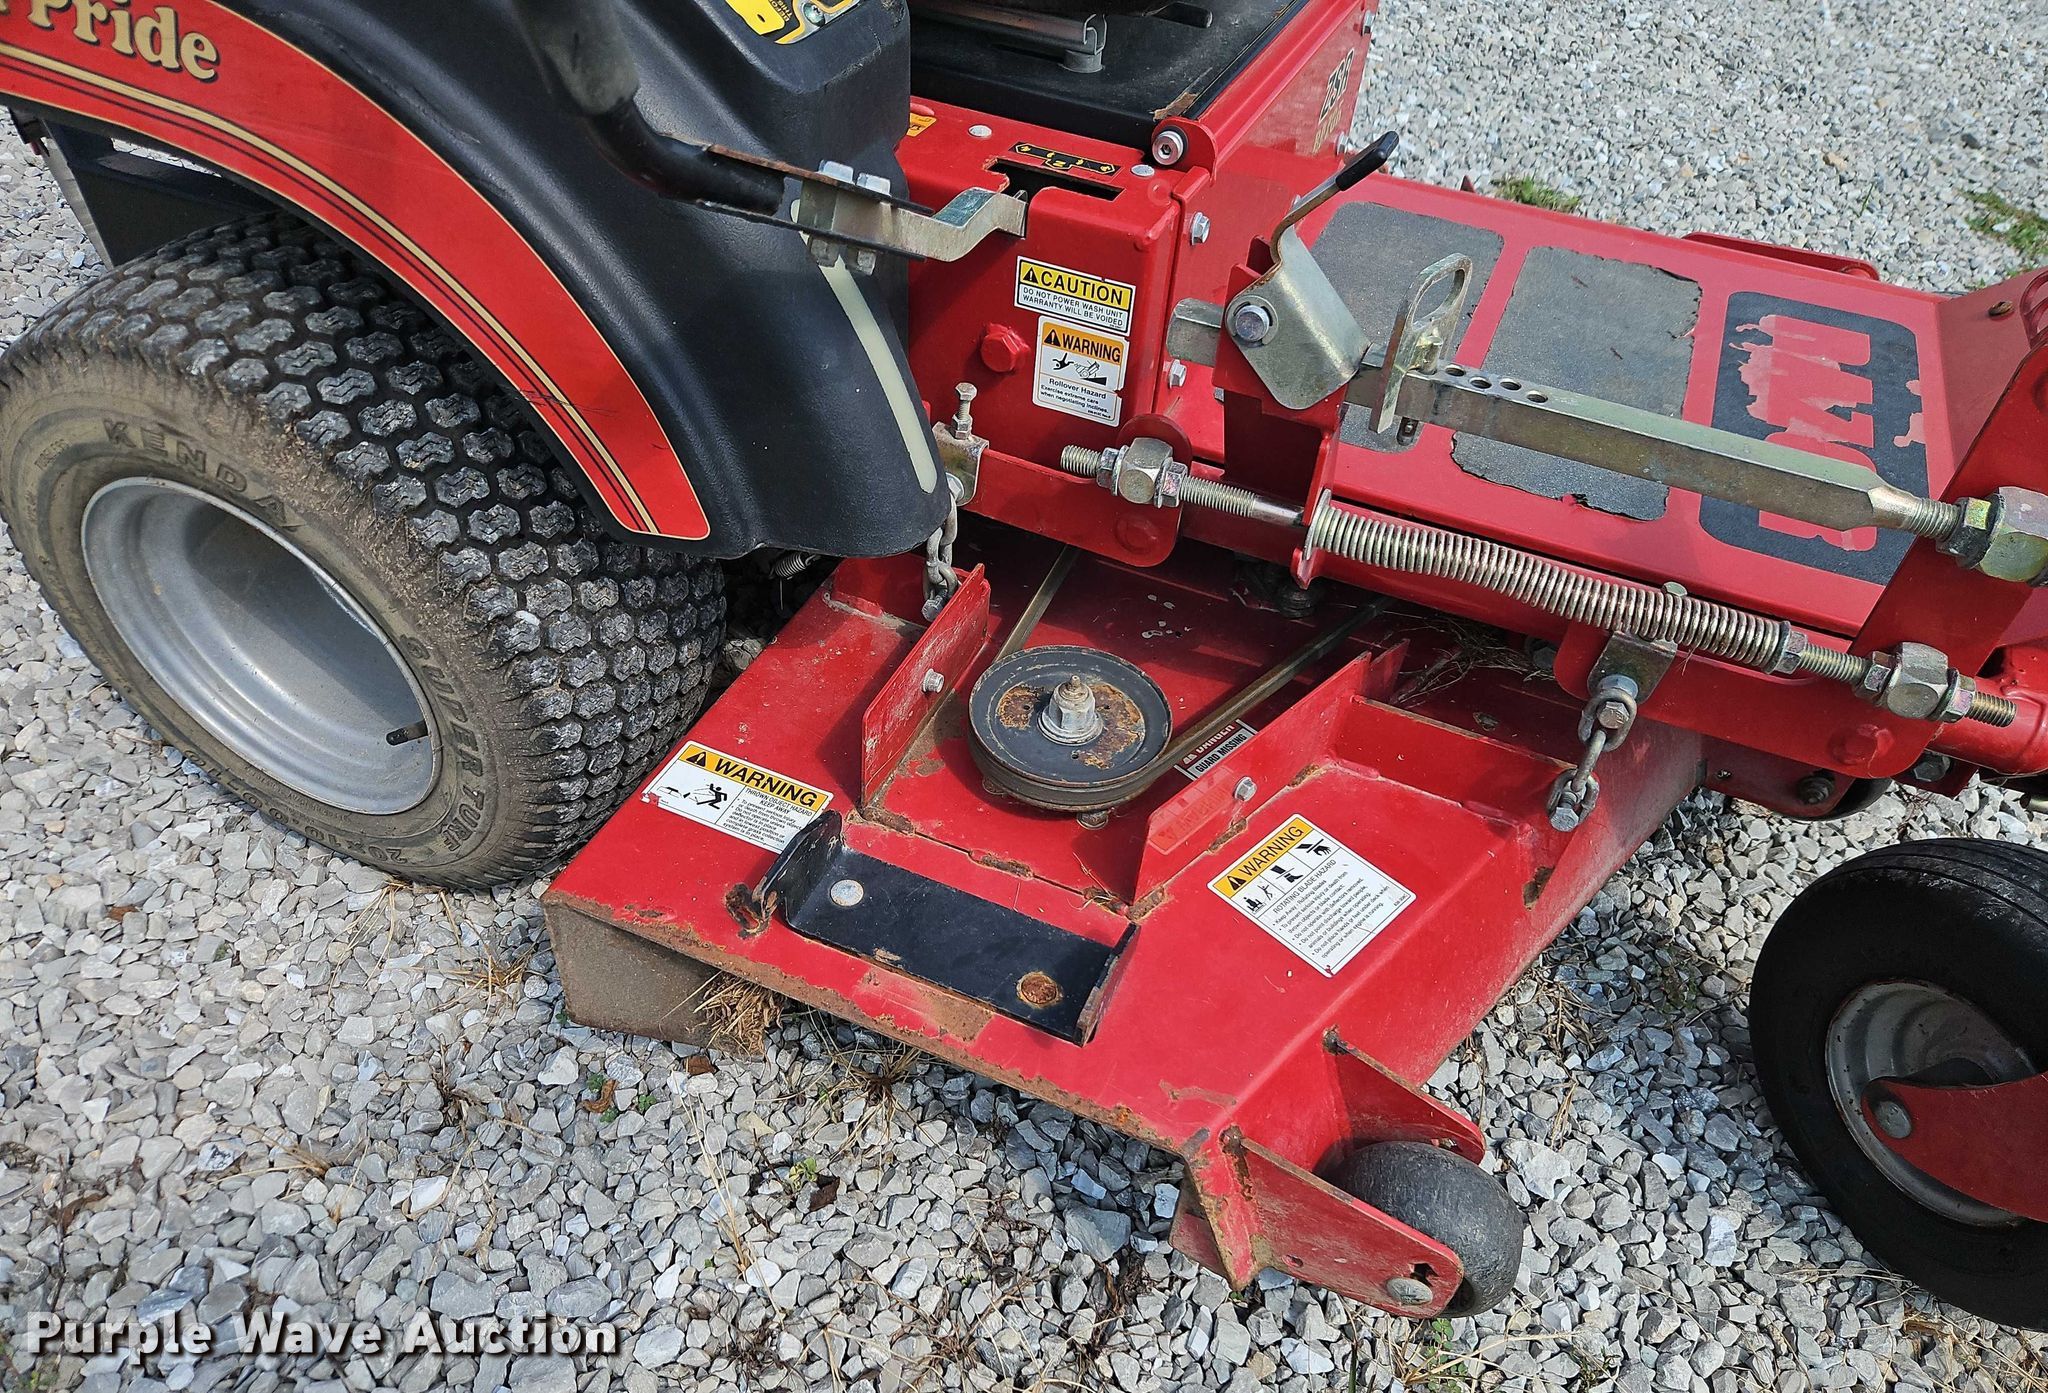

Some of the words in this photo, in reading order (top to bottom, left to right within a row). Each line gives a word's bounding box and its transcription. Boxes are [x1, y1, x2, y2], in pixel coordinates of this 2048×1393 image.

[1022, 286, 1033, 295] DO
[1035, 290, 1051, 299] NOT
[1052, 294, 1079, 307] POWER
[1081, 302, 1103, 313] WASH
[1105, 308, 1123, 318] UNIT
[1040, 270, 1122, 305] CAUTION
[1022, 294, 1062, 309] WARRANTY
[1064, 304, 1081, 315] WILL
[1083, 310, 1093, 318] BE
[1095, 313, 1122, 326] VOIDED
[1062, 332, 1121, 363] WARNING
[1048, 377, 1079, 391] Rollover
[1080, 386, 1106, 399] Hazard
[104, 418, 305, 528] KENDA
[401, 635, 484, 777] SUPER
[1195, 752, 1221, 773] GUARD
[1217, 733, 1248, 757] MISSING
[714, 757, 817, 807] WARNING
[745, 787, 768, 800] THROWN
[768, 796, 791, 808] OBJECT
[789, 804, 812, 816] HAZARD
[440, 785, 485, 851] TURF
[759, 799, 775, 807] KEEP
[774, 805, 790, 814] AWAY
[1237, 825, 1304, 876] WARNING
[1272, 890, 1300, 913] ROTATING
[1296, 875, 1317, 892] BLADE
[1314, 859, 1336, 878] HAZARD
[1274, 914, 1286, 923] Keep
[1284, 905, 1297, 915] Away
[1296, 890, 1315, 904] Rotating
[1311, 879, 1326, 891] Blades
[1286, 910, 1302, 925] prevent
[1300, 900, 1315, 912] serious
[1312, 891, 1325, 901] injury
[1328, 878, 1339, 888] death
[1337, 871, 1347, 879] from
[1287, 921, 1302, 933] thrown
[1300, 909, 1316, 922] objects
[1317, 896, 1330, 906] blade
[1300, 925, 1309, 933] not
[1306, 914, 1322, 927] operate
[1321, 907, 1330, 915] with
[1329, 891, 1348, 908] deflectors
[1306, 930, 1315, 938] not
[1313, 922, 1325, 933] point
[1323, 907, 1342, 923] discharge
[1339, 895, 1354, 908] toward
[1307, 934, 1323, 948] animals
[1325, 915, 1344, 931] buildings
[1342, 907, 1352, 916] when
[1320, 940, 1328, 948] not
[1326, 931, 1338, 943] place
[1336, 921, 1350, 932] hands
[1351, 910, 1361, 918] feet
[1359, 901, 1371, 912] under
[1370, 894, 1380, 902] deck
[1378, 885, 1389, 894] when
